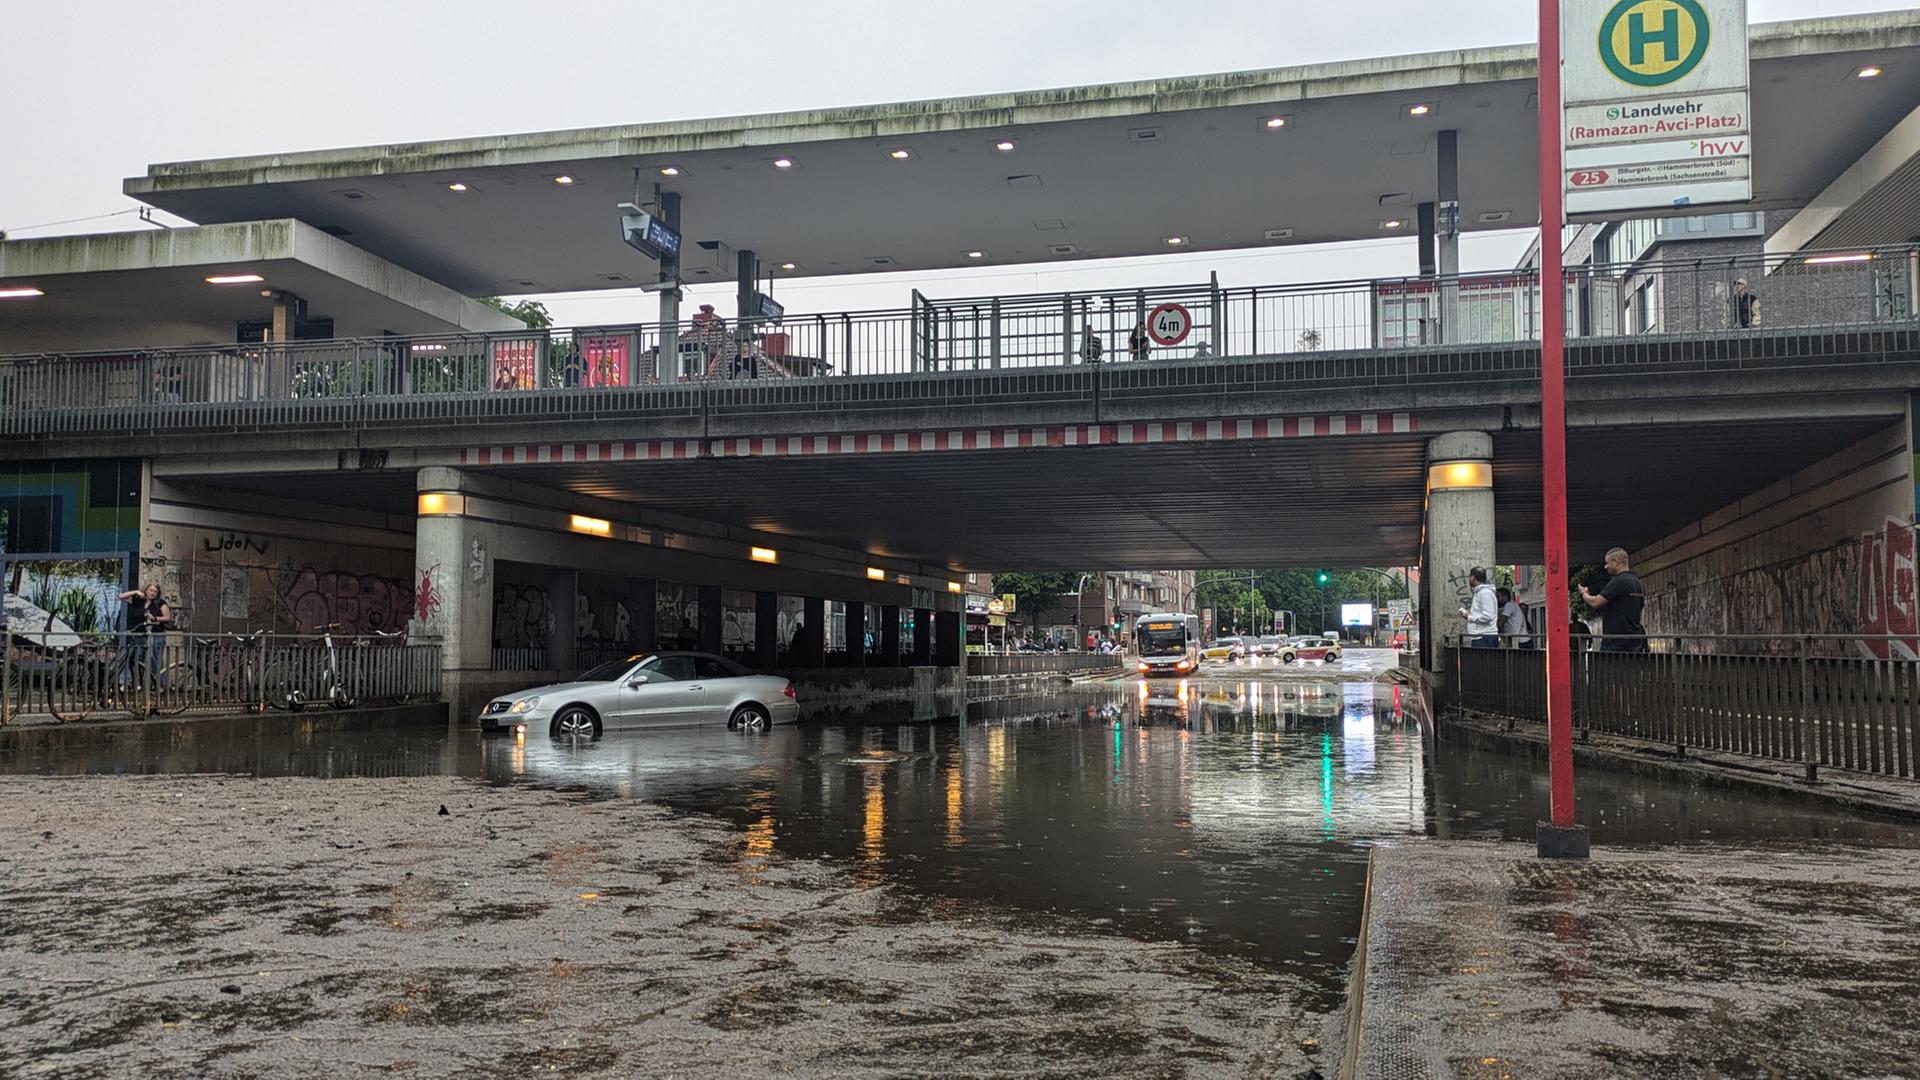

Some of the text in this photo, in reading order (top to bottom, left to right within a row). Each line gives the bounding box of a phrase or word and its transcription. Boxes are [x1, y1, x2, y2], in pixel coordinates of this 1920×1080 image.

[1628, 8, 1679, 65] H
[1622, 101, 1703, 119] Landwehr
[1569, 113, 1742, 141] (Ramazan-Avci-Platz)
[1663, 161, 1714, 171] Hammerbrook
[1580, 172, 1600, 185] 25
[1617, 169, 1727, 184] Hammerbrook (Sachsenstraße)
